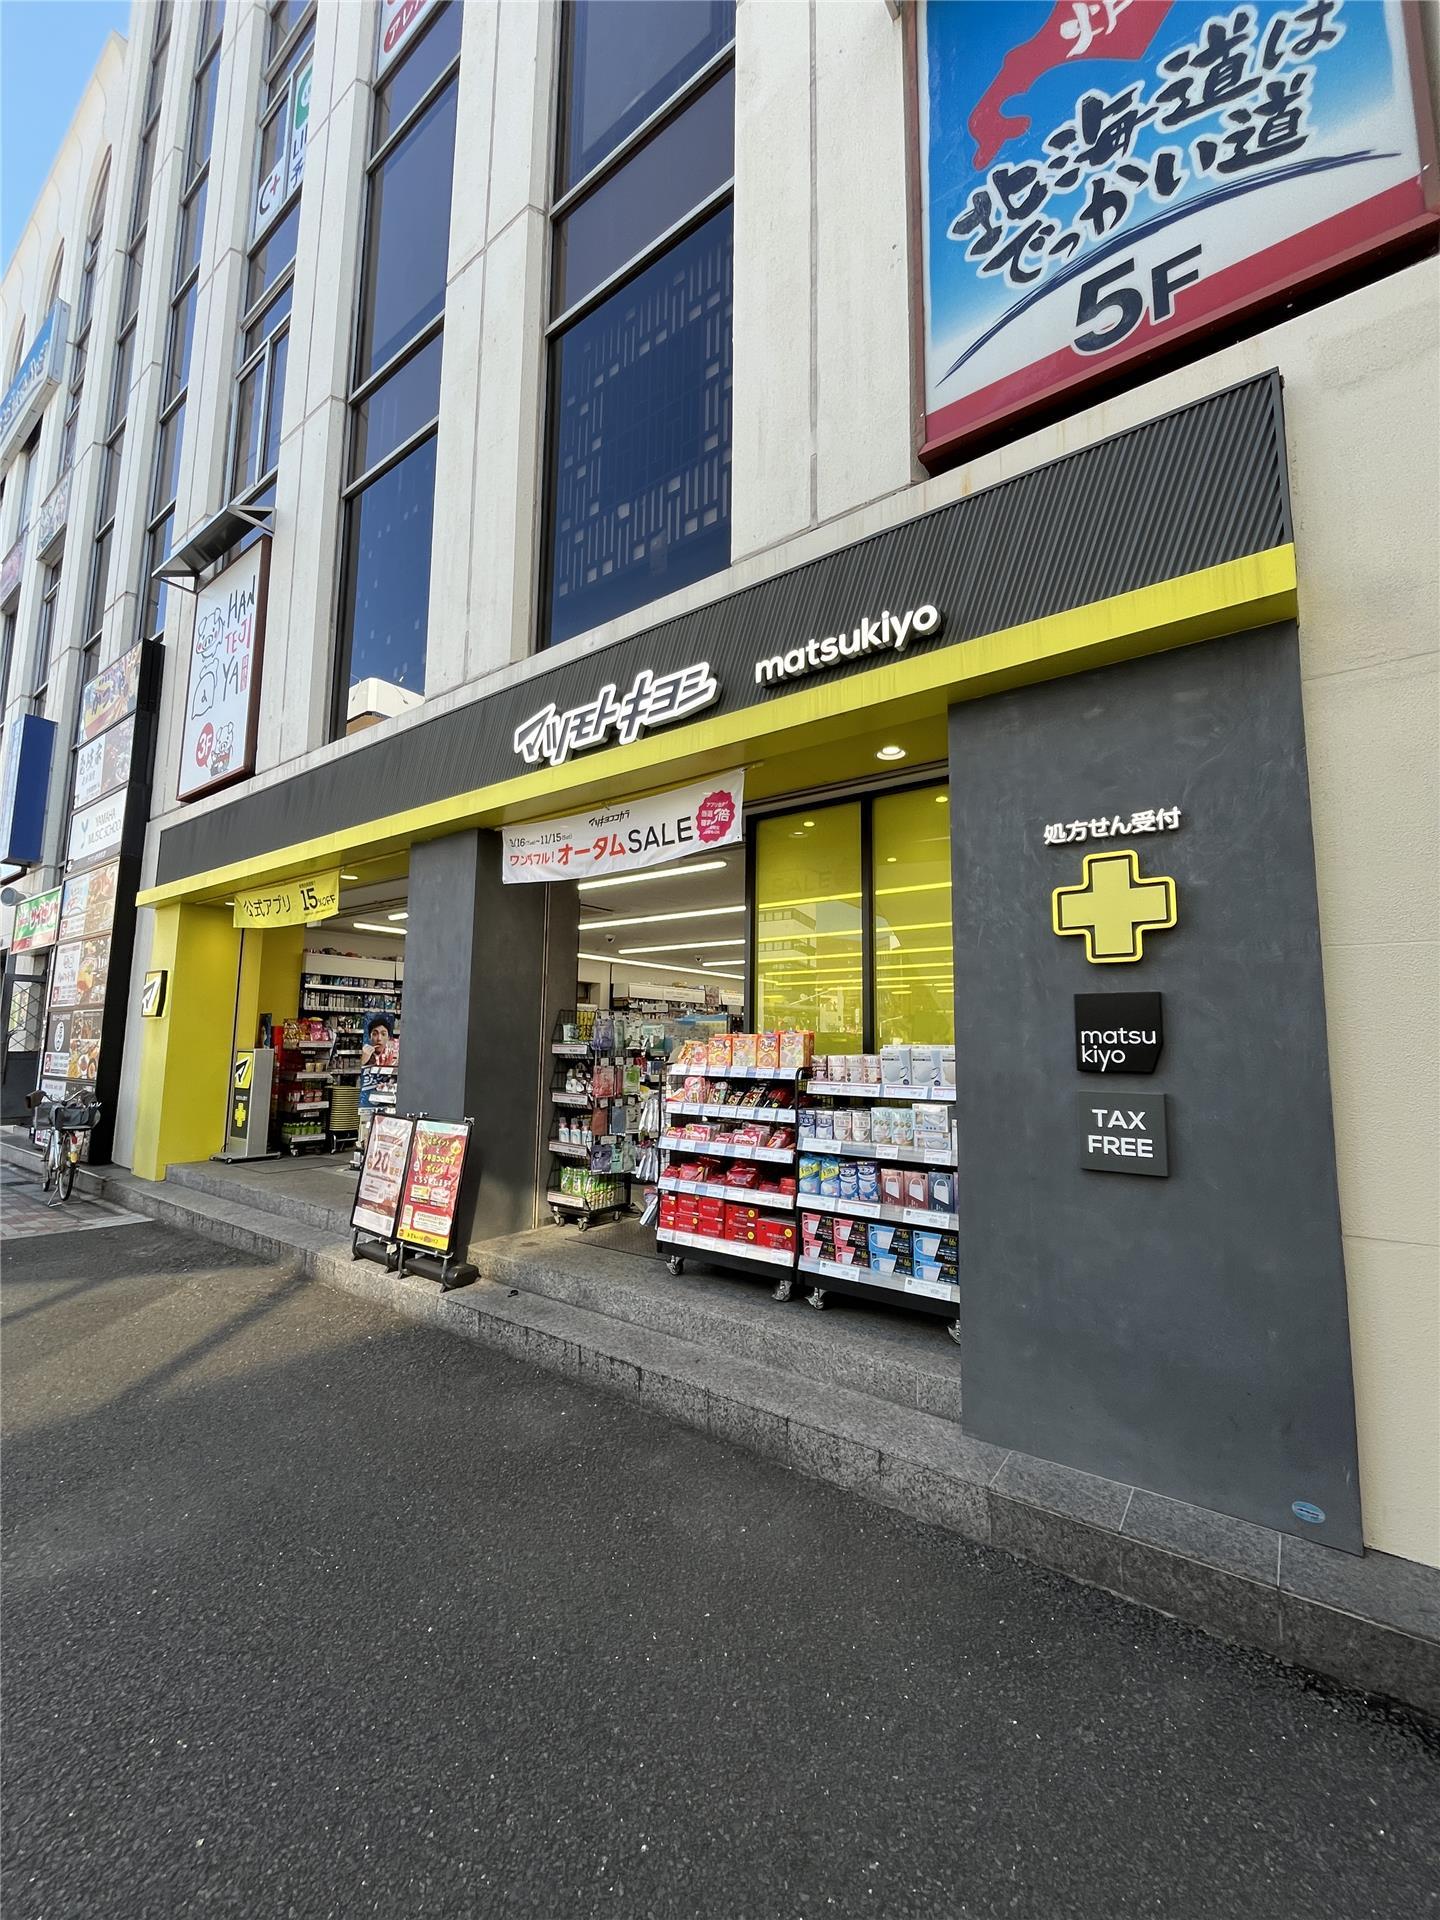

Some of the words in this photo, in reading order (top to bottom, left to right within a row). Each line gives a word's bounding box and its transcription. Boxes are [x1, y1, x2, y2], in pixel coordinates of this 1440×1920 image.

[953, 2, 1338, 256] 北海道は
[983, 73, 1309, 283] でっかい道
[1074, 244, 1202, 352] 5F
[227, 574, 256, 628] HAN
[755, 604, 938, 684] matsukiyo
[514, 662, 717, 766] マツモトキヨシ
[197, 732, 212, 760] 3F
[1043, 806, 1182, 846] 処方せん受付
[243, 894, 291, 918] 公式アプリ
[1080, 1028, 1157, 1046] matsu
[1080, 1045, 1126, 1072] kiyo
[1092, 1109, 1146, 1131] TAX
[1088, 1134, 1154, 1159] FREE
